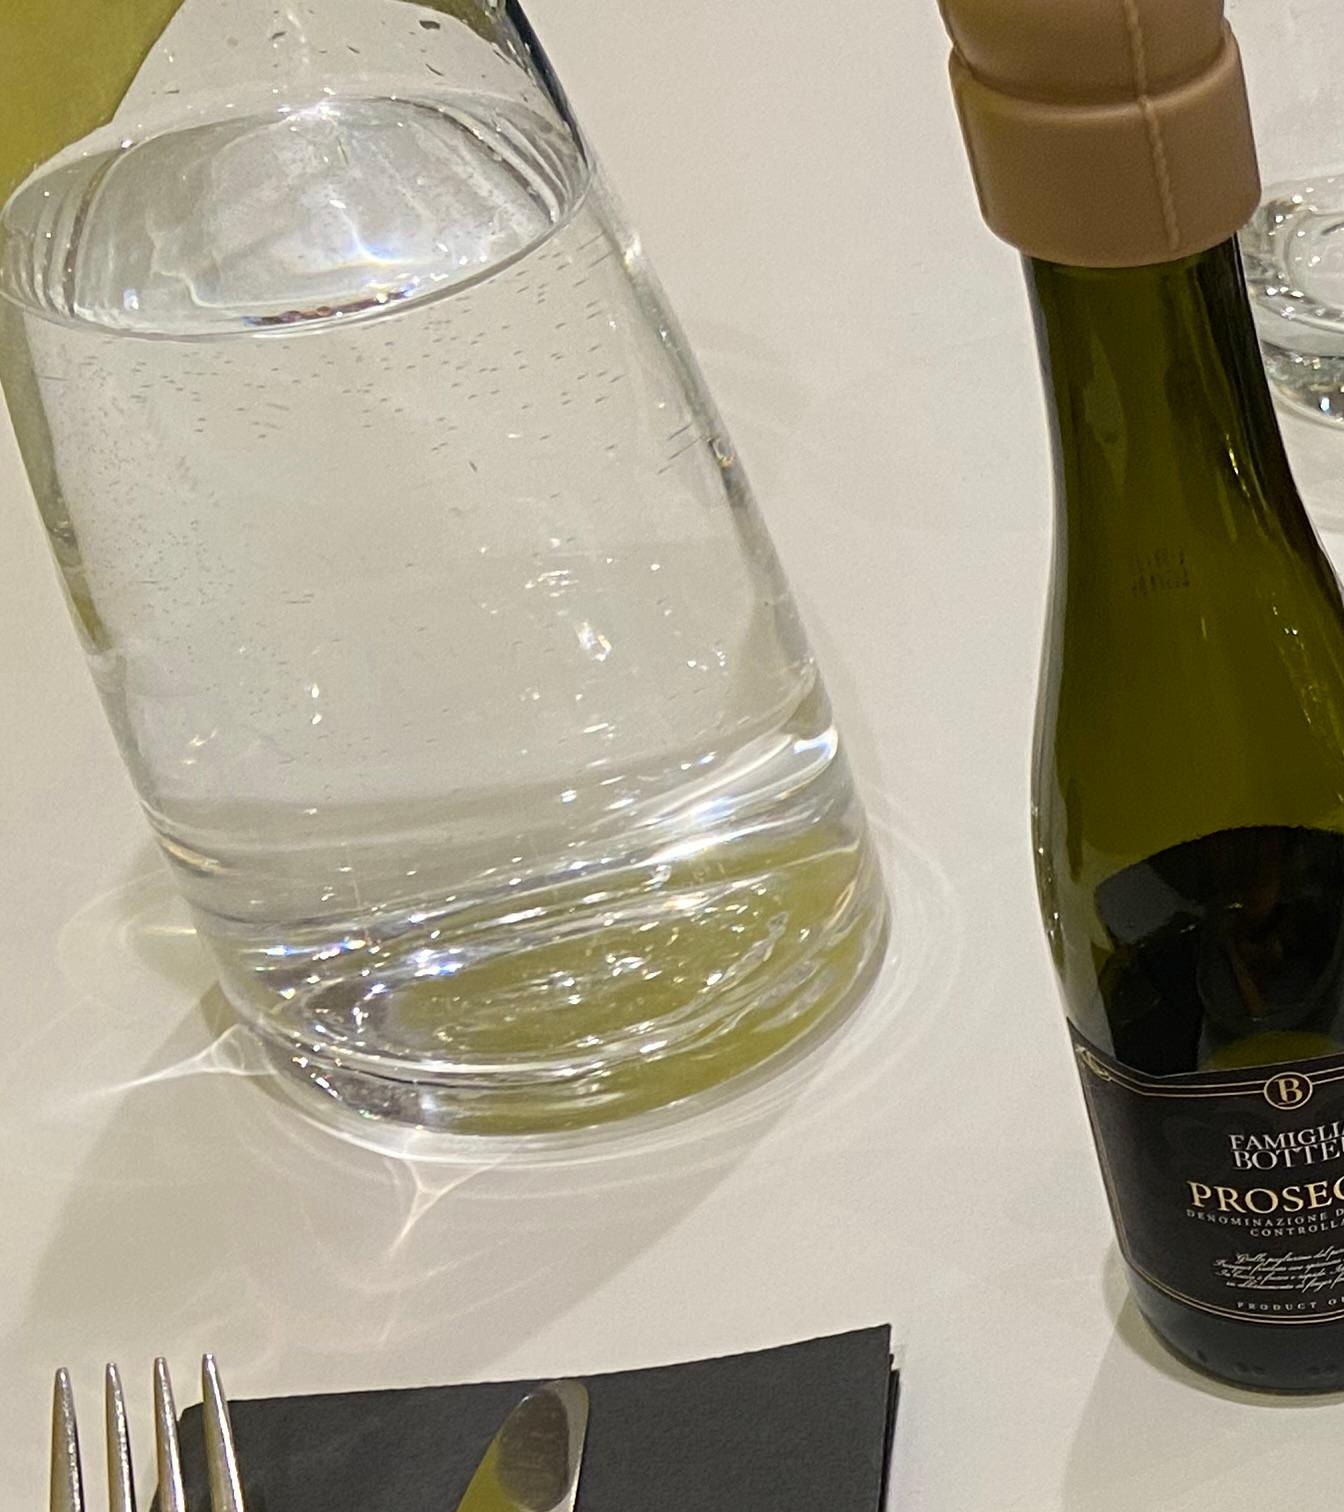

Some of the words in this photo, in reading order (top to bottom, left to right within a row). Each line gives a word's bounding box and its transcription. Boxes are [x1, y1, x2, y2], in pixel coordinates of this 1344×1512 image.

[1276, 1077, 1304, 1106] B
[1186, 1208, 1329, 1227] DENOMINAZIONE
[1236, 1300, 1318, 1311] PRODUCT
